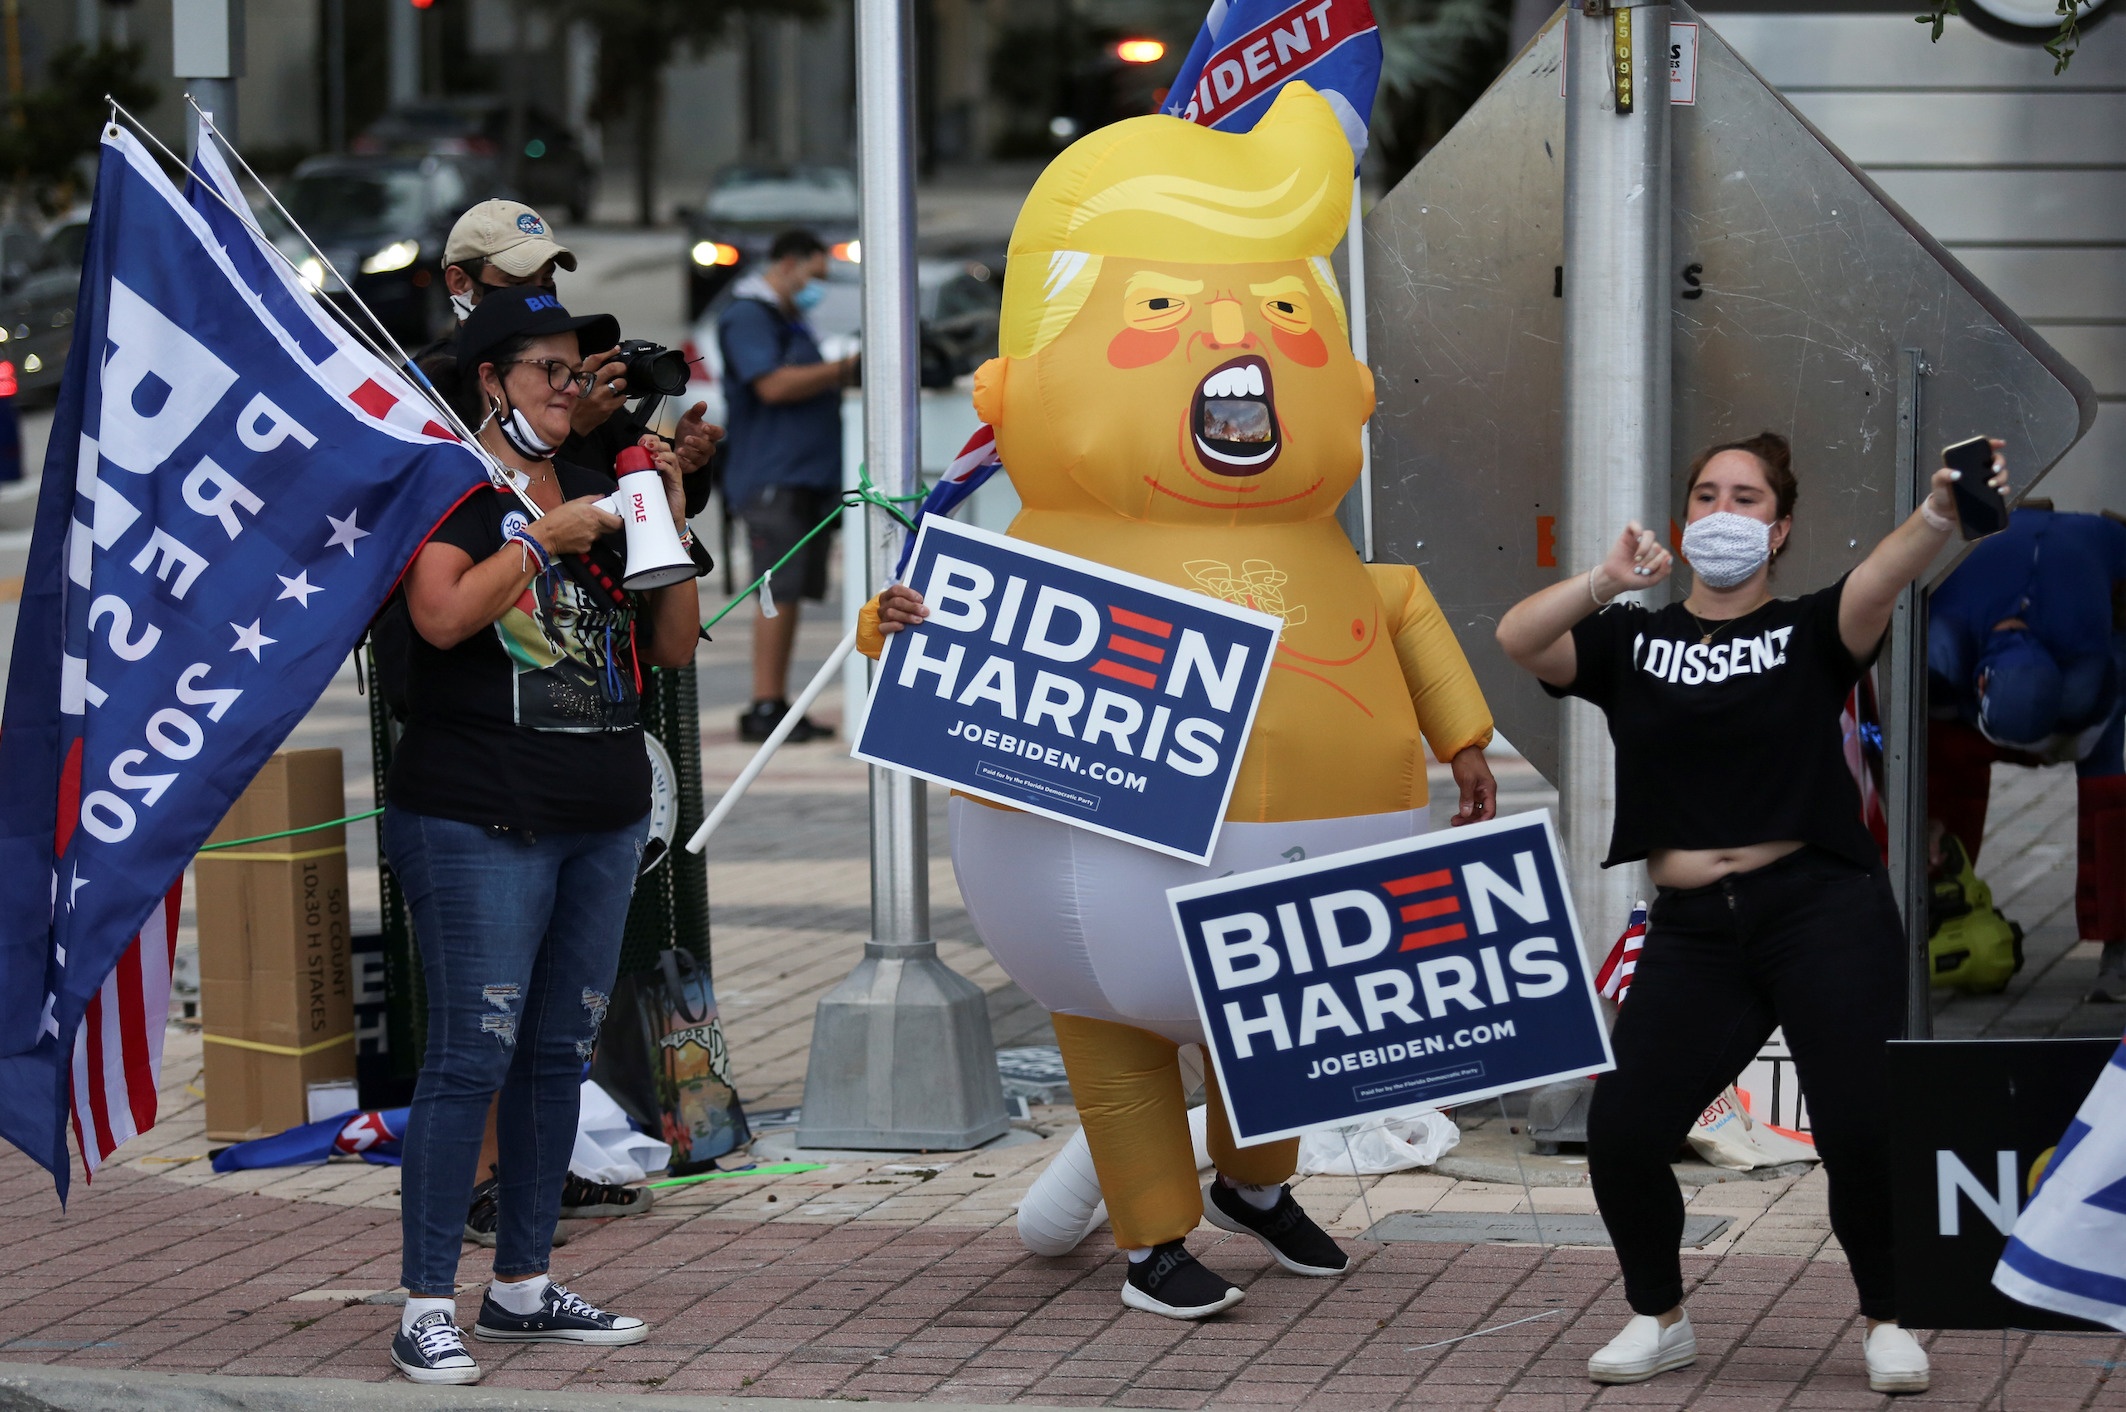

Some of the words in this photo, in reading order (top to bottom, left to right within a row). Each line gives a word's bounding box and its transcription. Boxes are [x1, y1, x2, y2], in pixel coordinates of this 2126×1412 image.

[1183, 0, 1333, 123] SIDENT
[632, 493, 647, 523] PYLE
[922, 553, 1250, 713] BIDEN
[1643, 625, 1794, 686] DISSENT
[898, 632, 1225, 777] HARRIS
[948, 720, 1148, 793] JOEBIDEN.COM
[982, 767, 996, 776] Paid
[996, 770, 1005, 779] for
[1005, 773, 1013, 782] by
[1013, 775, 1024, 785] the
[1023, 780, 1044, 791] Florida
[1044, 785, 1078, 801] Democratic
[1078, 796, 1094, 806] Party
[303, 862, 321, 927] 10x30
[327, 888, 342, 915] 50
[1200, 850, 1550, 991] BIDEN
[308, 933, 322, 948] H
[329, 921, 346, 997] COUNT
[308, 954, 326, 1032] STAKES
[1223, 936, 1570, 1060] HARRIS
[1307, 1019, 1517, 1080] JOEBIDEN.COM
[1404, 1078, 1427, 1088] Florida
[1426, 1072, 1461, 1083] Democratic
[1461, 1067, 1478, 1076] Party
